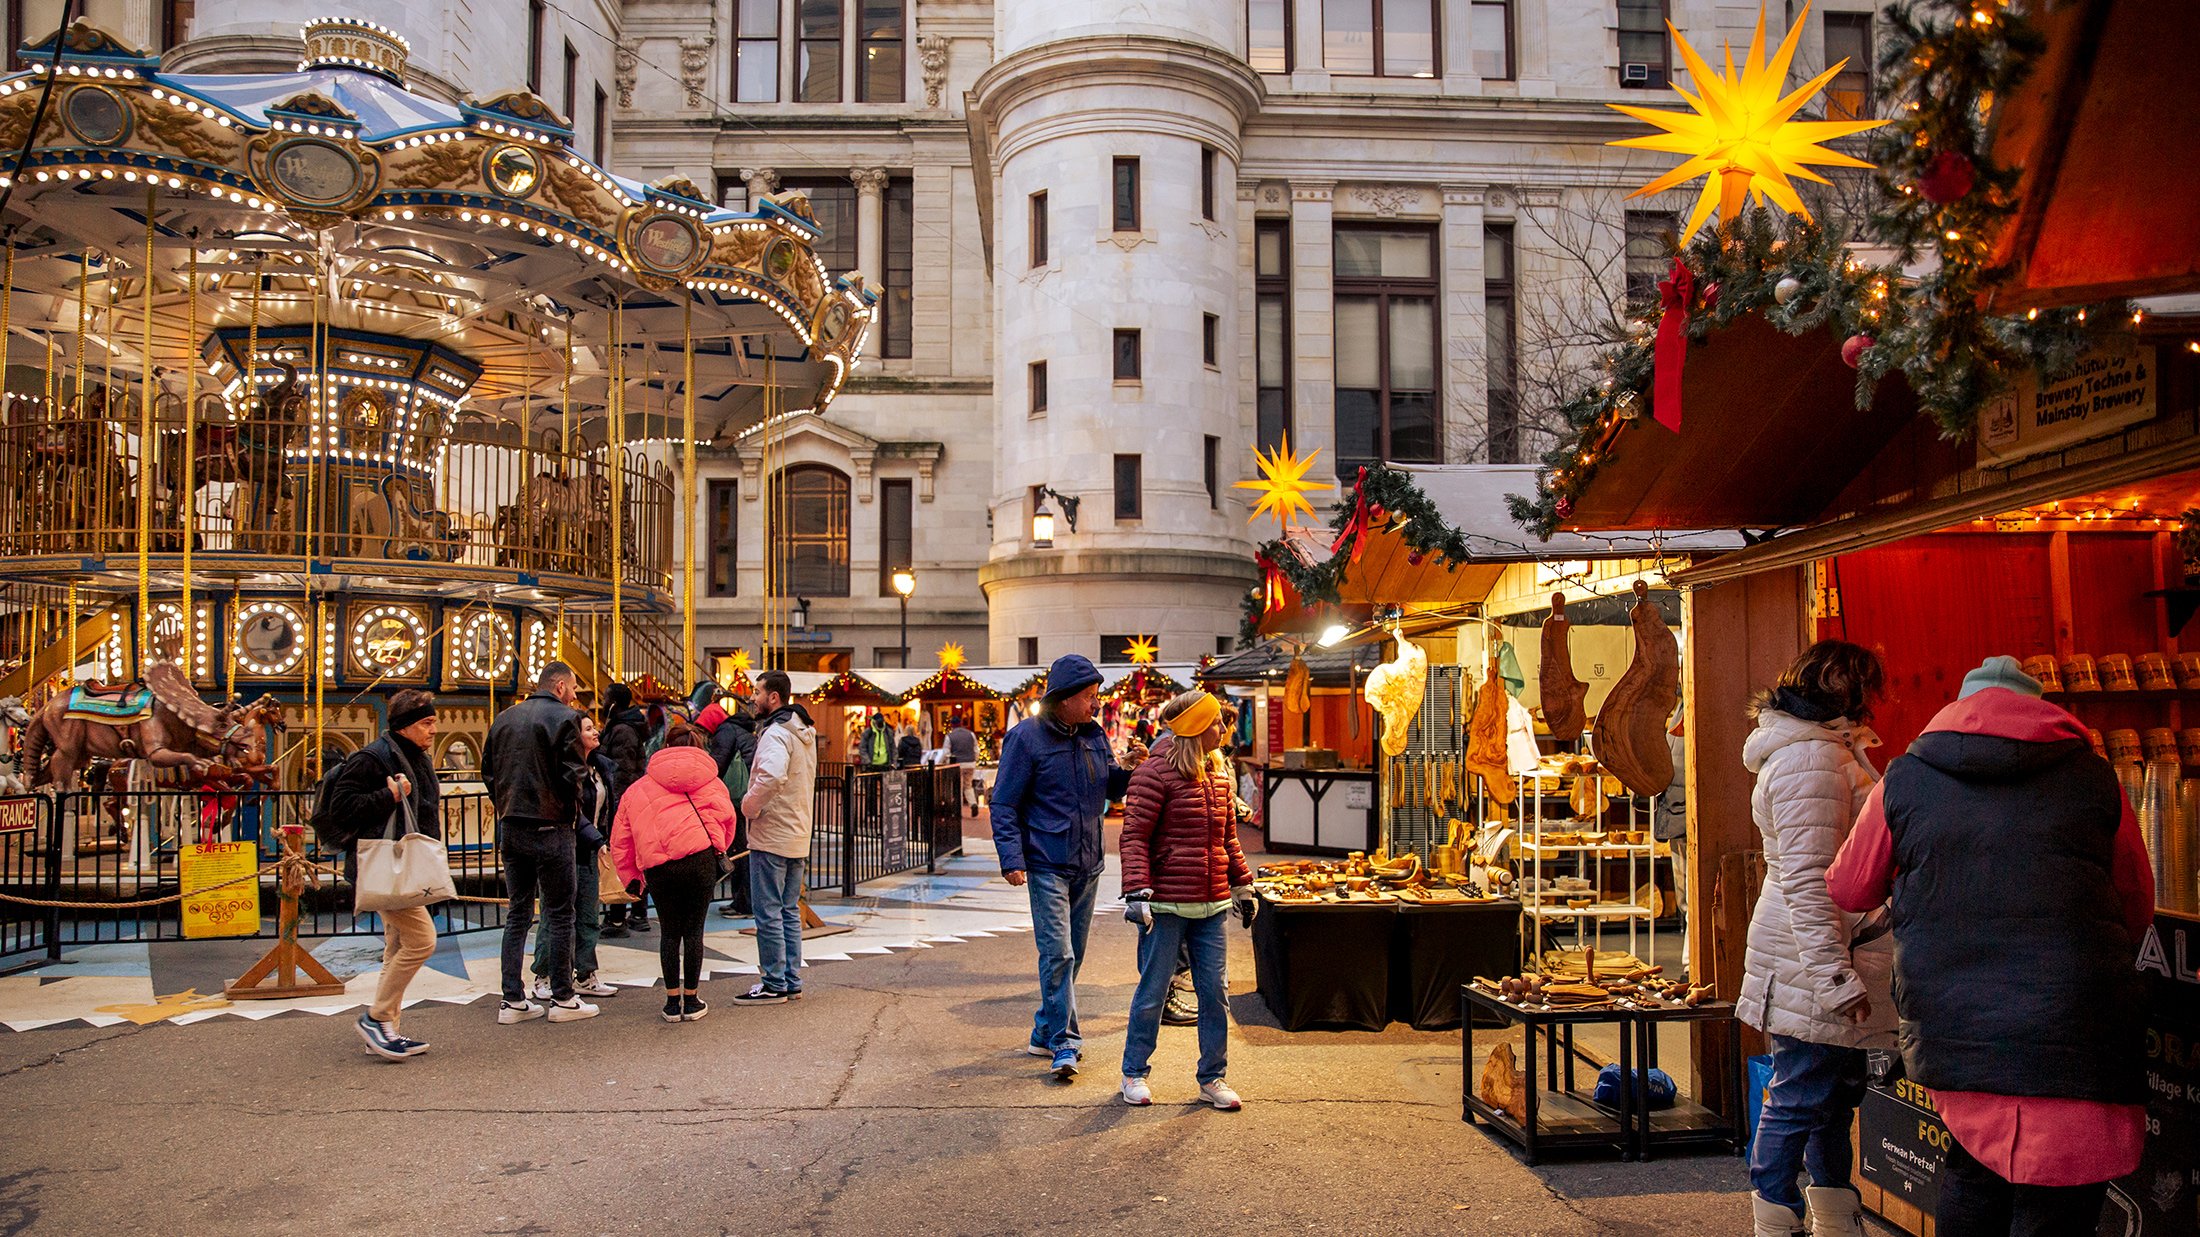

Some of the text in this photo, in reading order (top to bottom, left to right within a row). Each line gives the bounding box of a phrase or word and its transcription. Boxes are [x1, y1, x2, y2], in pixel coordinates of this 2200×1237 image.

[647, 229, 690, 253] Westfield
[2036, 363, 2147, 408] Brewery Techne &
[2036, 387, 2146, 427] Mainstay Brewery
[1882, 1137, 1908, 1159] German
[1909, 1150, 1936, 1174] Pretzel
